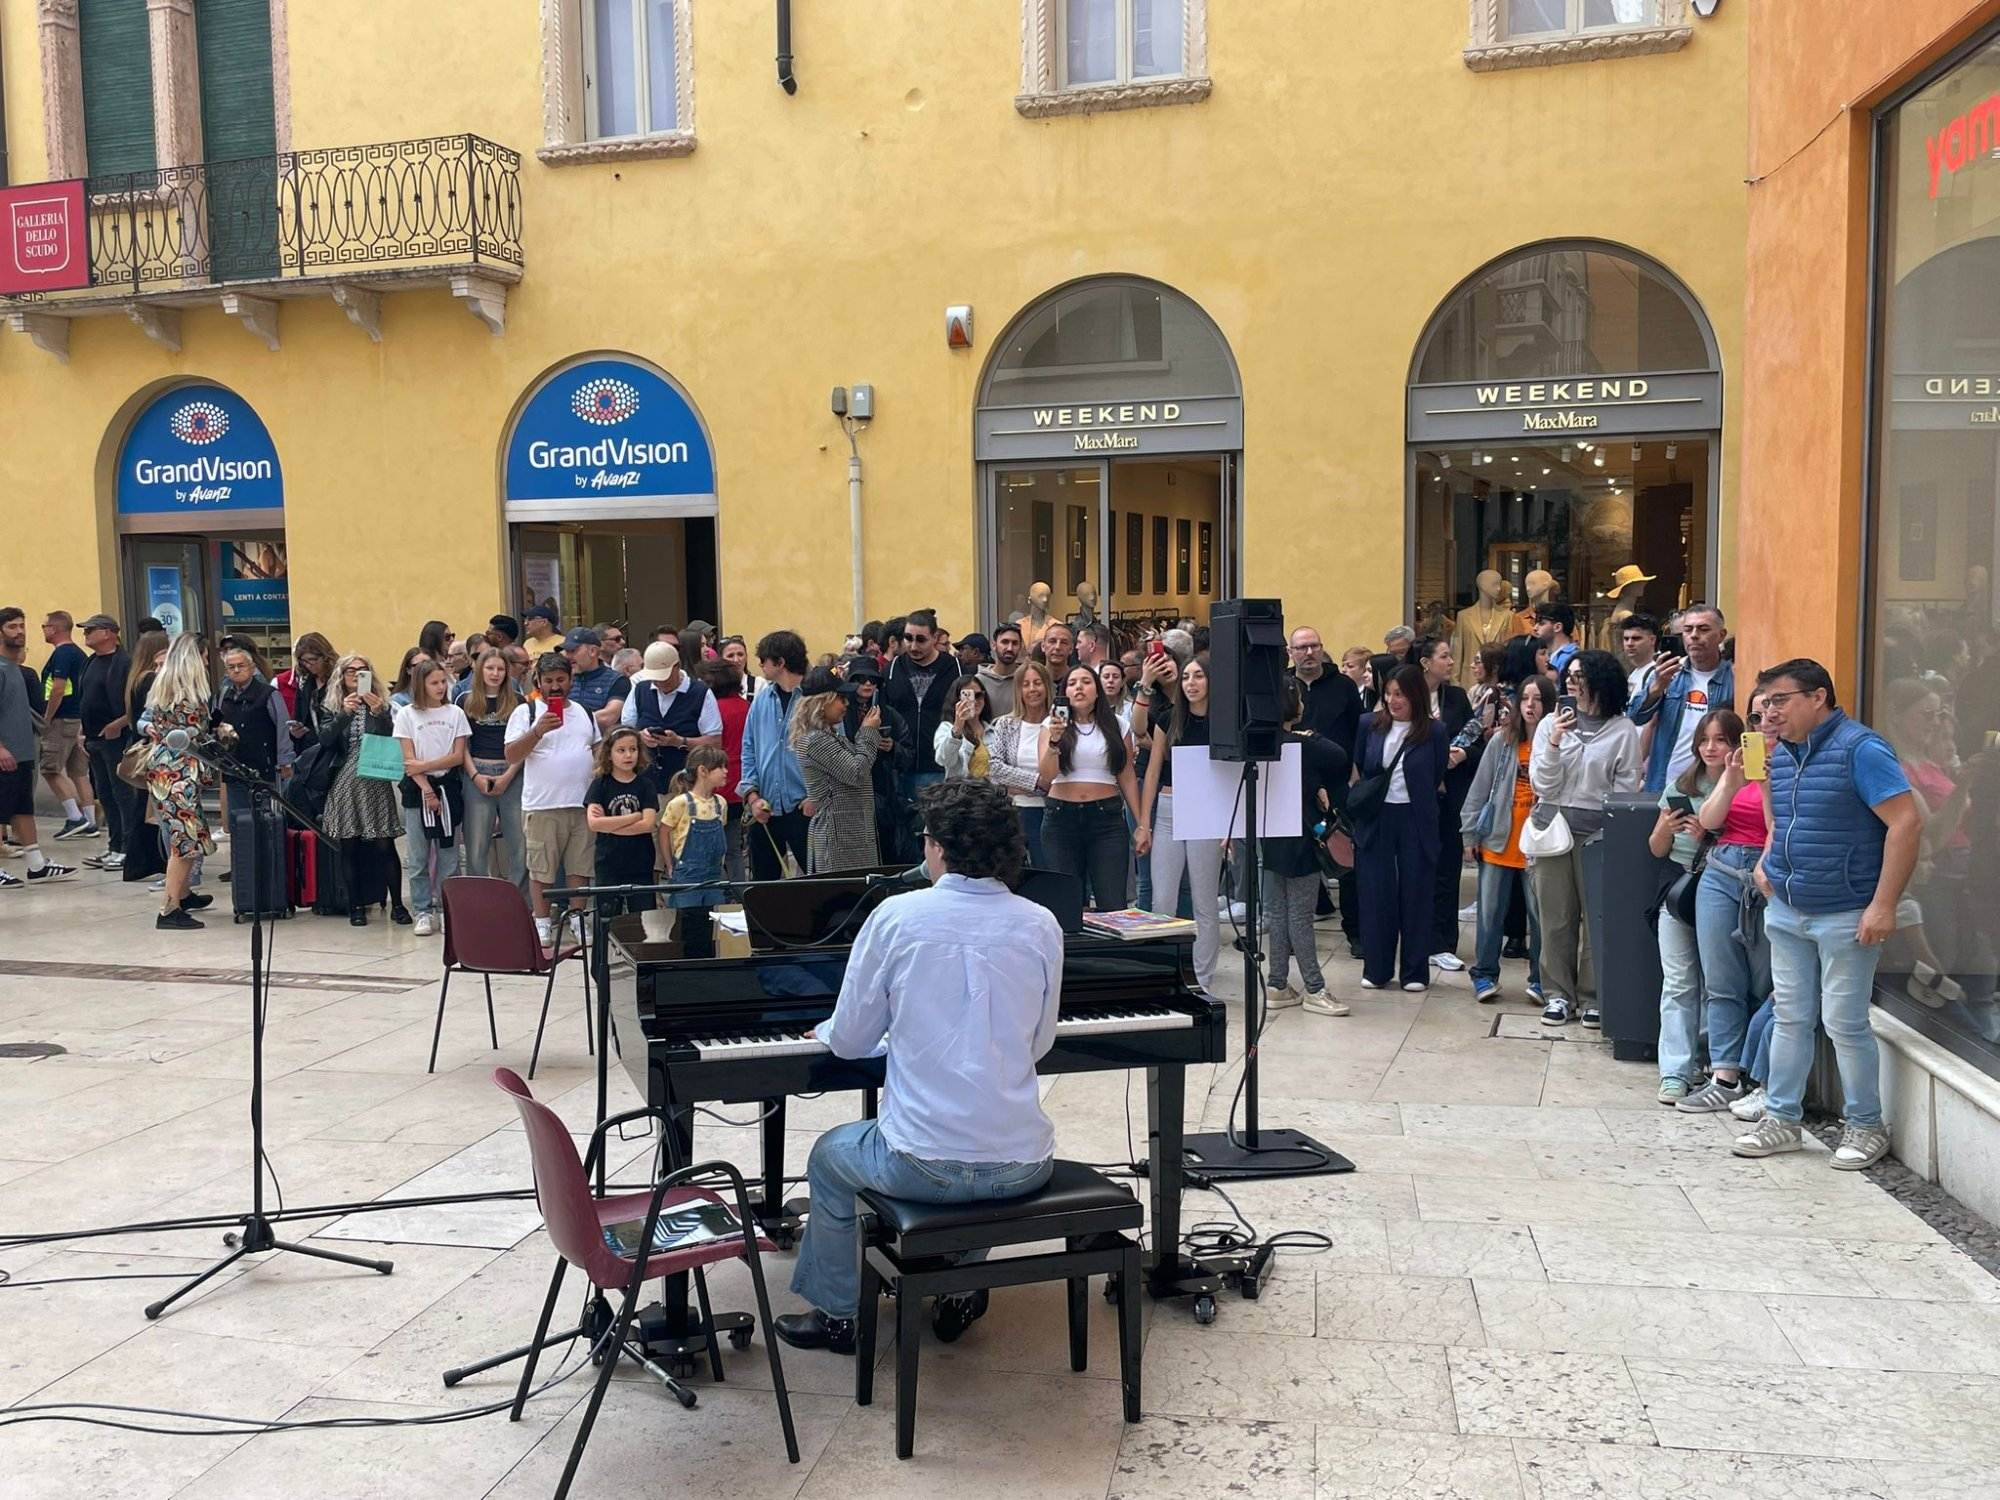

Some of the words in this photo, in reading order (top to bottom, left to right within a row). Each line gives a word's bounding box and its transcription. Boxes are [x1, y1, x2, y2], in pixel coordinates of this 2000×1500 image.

[16, 212, 64, 228] GALLERIA
[25, 228, 57, 243] DELLO
[25, 243, 58, 258] SCUDO
[1476, 379, 1649, 404] WEEKEND
[1033, 403, 1181, 426] WEEKEND
[1523, 411, 1598, 430] MaxMara
[1073, 432, 1138, 450] MaxMara
[528, 438, 688, 469] GrandVision
[136, 456, 272, 485] GrandVision
[575, 474, 588, 488] by
[175, 489, 187, 502] by
[233, 593, 254, 601] LENTI
[255, 593, 261, 601] A
